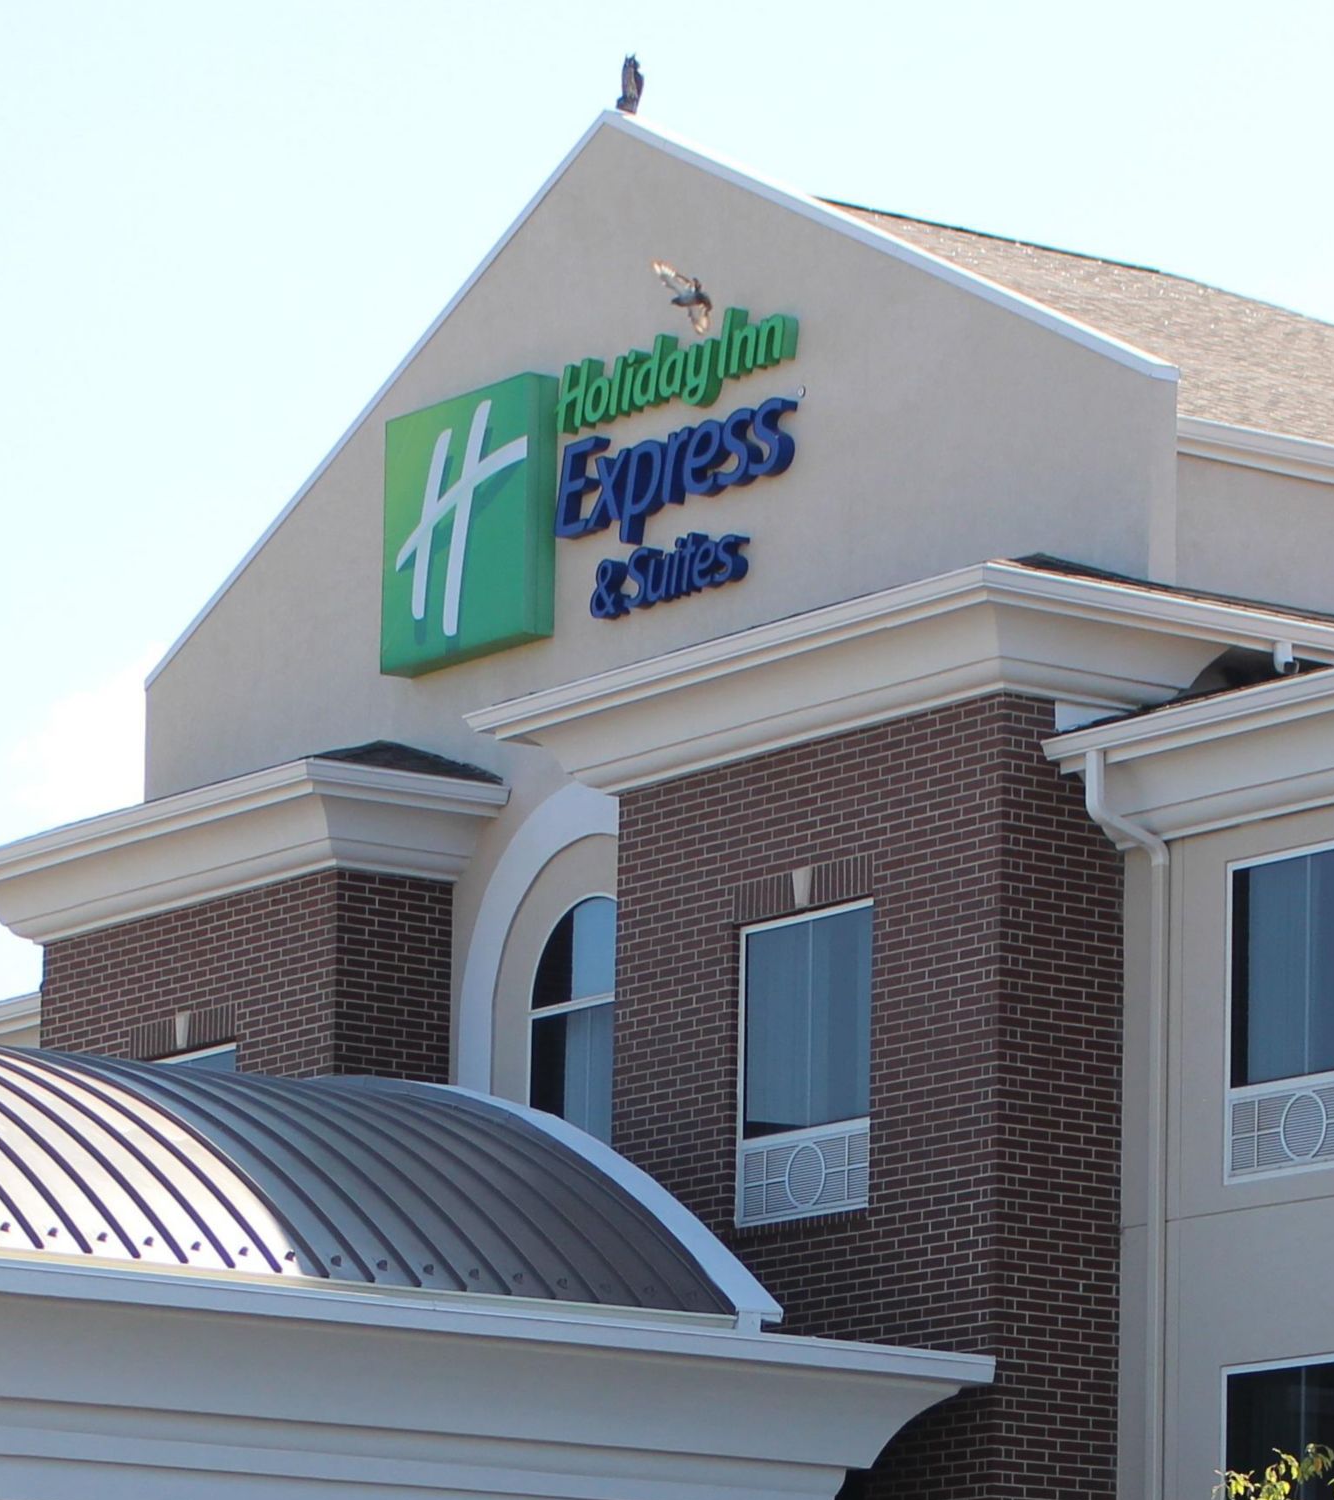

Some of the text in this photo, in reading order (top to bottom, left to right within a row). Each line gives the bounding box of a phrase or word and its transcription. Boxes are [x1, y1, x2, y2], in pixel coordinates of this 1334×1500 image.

[556, 308, 799, 434] Holiday Inn
[396, 399, 528, 637] H
[555, 397, 798, 545] Express
[590, 532, 750, 620] & Suites
